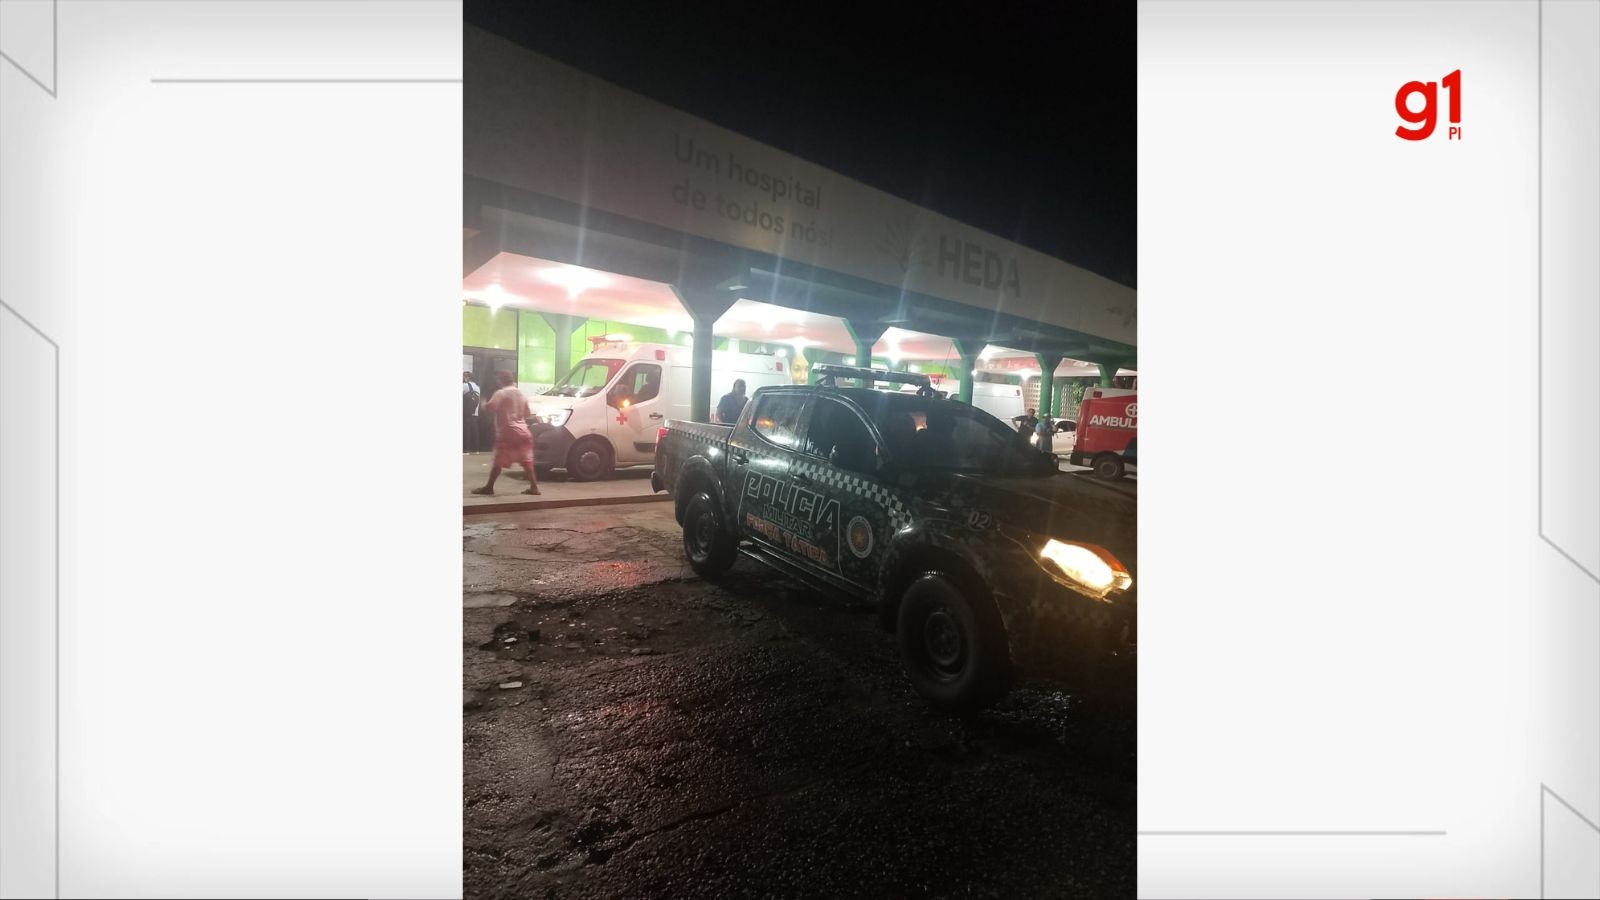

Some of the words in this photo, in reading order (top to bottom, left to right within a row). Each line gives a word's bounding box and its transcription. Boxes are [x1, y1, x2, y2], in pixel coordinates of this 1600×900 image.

[674, 133, 719, 175] Um
[728, 151, 820, 209] hospital
[671, 179, 706, 209] de
[716, 193, 785, 235] todos
[937, 234, 1021, 298] HEDA
[1089, 415, 1137, 429] AMBUL
[763, 503, 813, 539] MILITAR
[967, 511, 989, 529] 02
